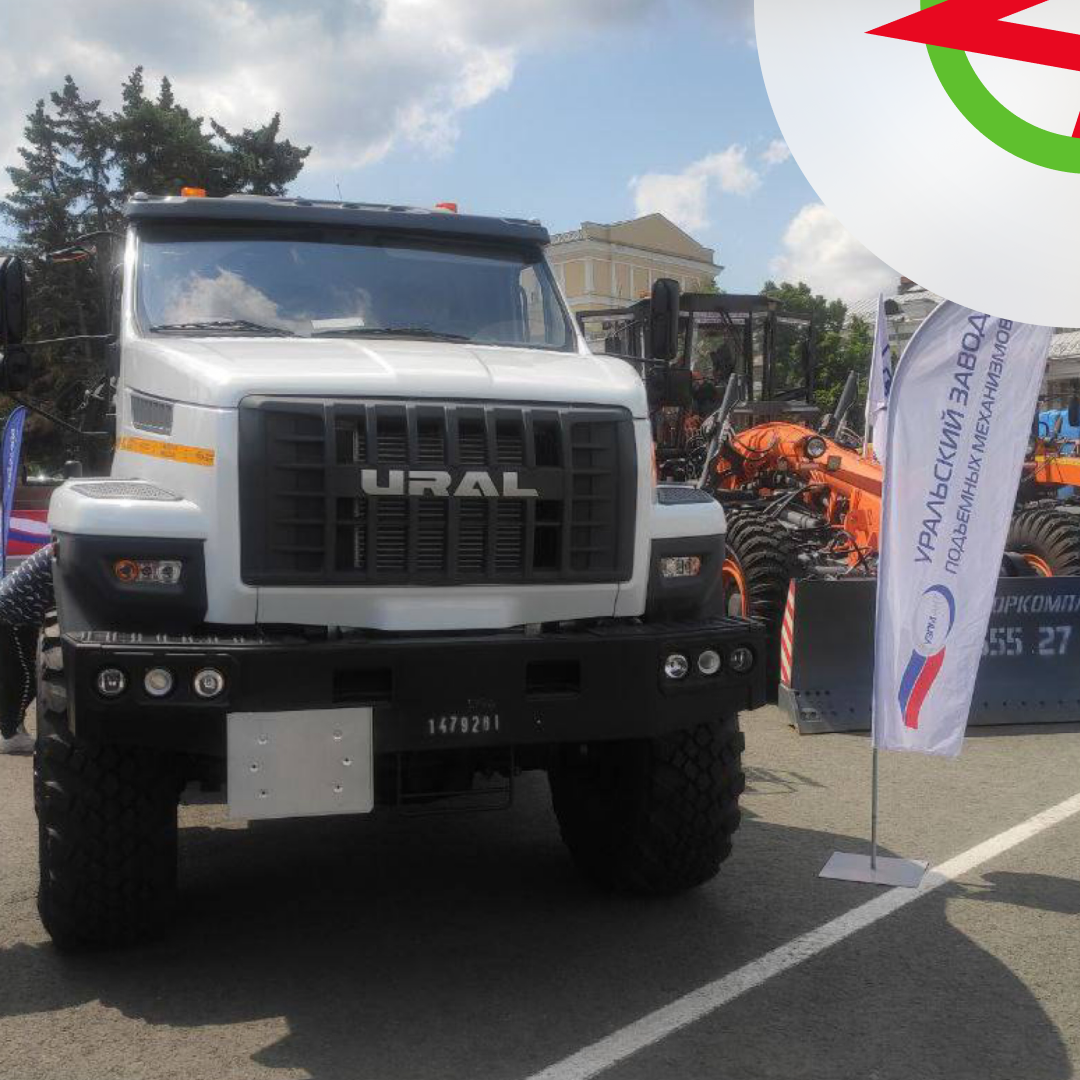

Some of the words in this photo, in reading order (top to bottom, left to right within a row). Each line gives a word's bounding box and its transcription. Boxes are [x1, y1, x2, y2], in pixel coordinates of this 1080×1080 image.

[361, 469, 539, 497] URAL
[914, 409, 964, 563] УРАЛЬСКИЙ
[949, 313, 990, 407] ЗАВОД
[944, 453, 983, 575] ПОДЪЕМНЫХ
[974, 318, 1013, 454] МЕХАНИЗМОВ
[1038, 625, 1072, 655] 27
